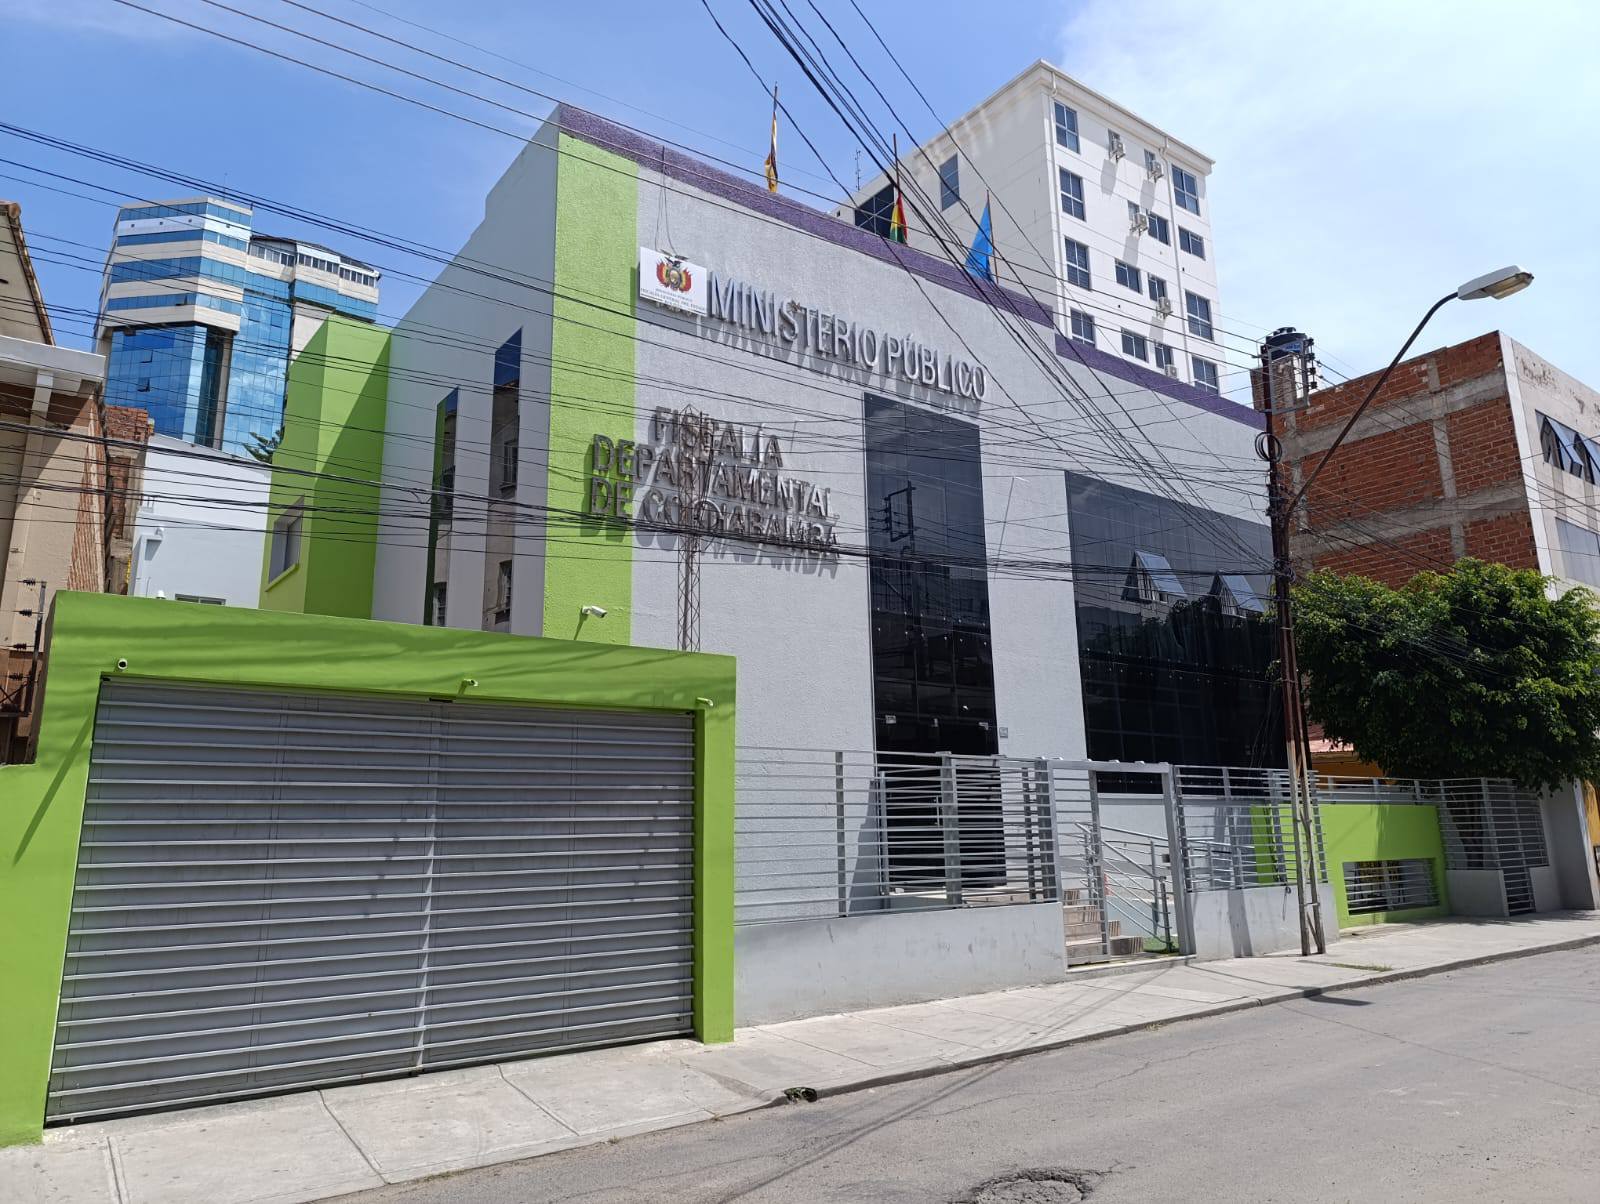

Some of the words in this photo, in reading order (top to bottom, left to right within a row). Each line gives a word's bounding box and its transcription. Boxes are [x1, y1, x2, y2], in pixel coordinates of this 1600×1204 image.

[709, 271, 878, 368] MINISTERIO
[885, 332, 987, 401] PÚBLICO
[591, 476, 633, 518] DE
[641, 487, 842, 556] COABAMBA
